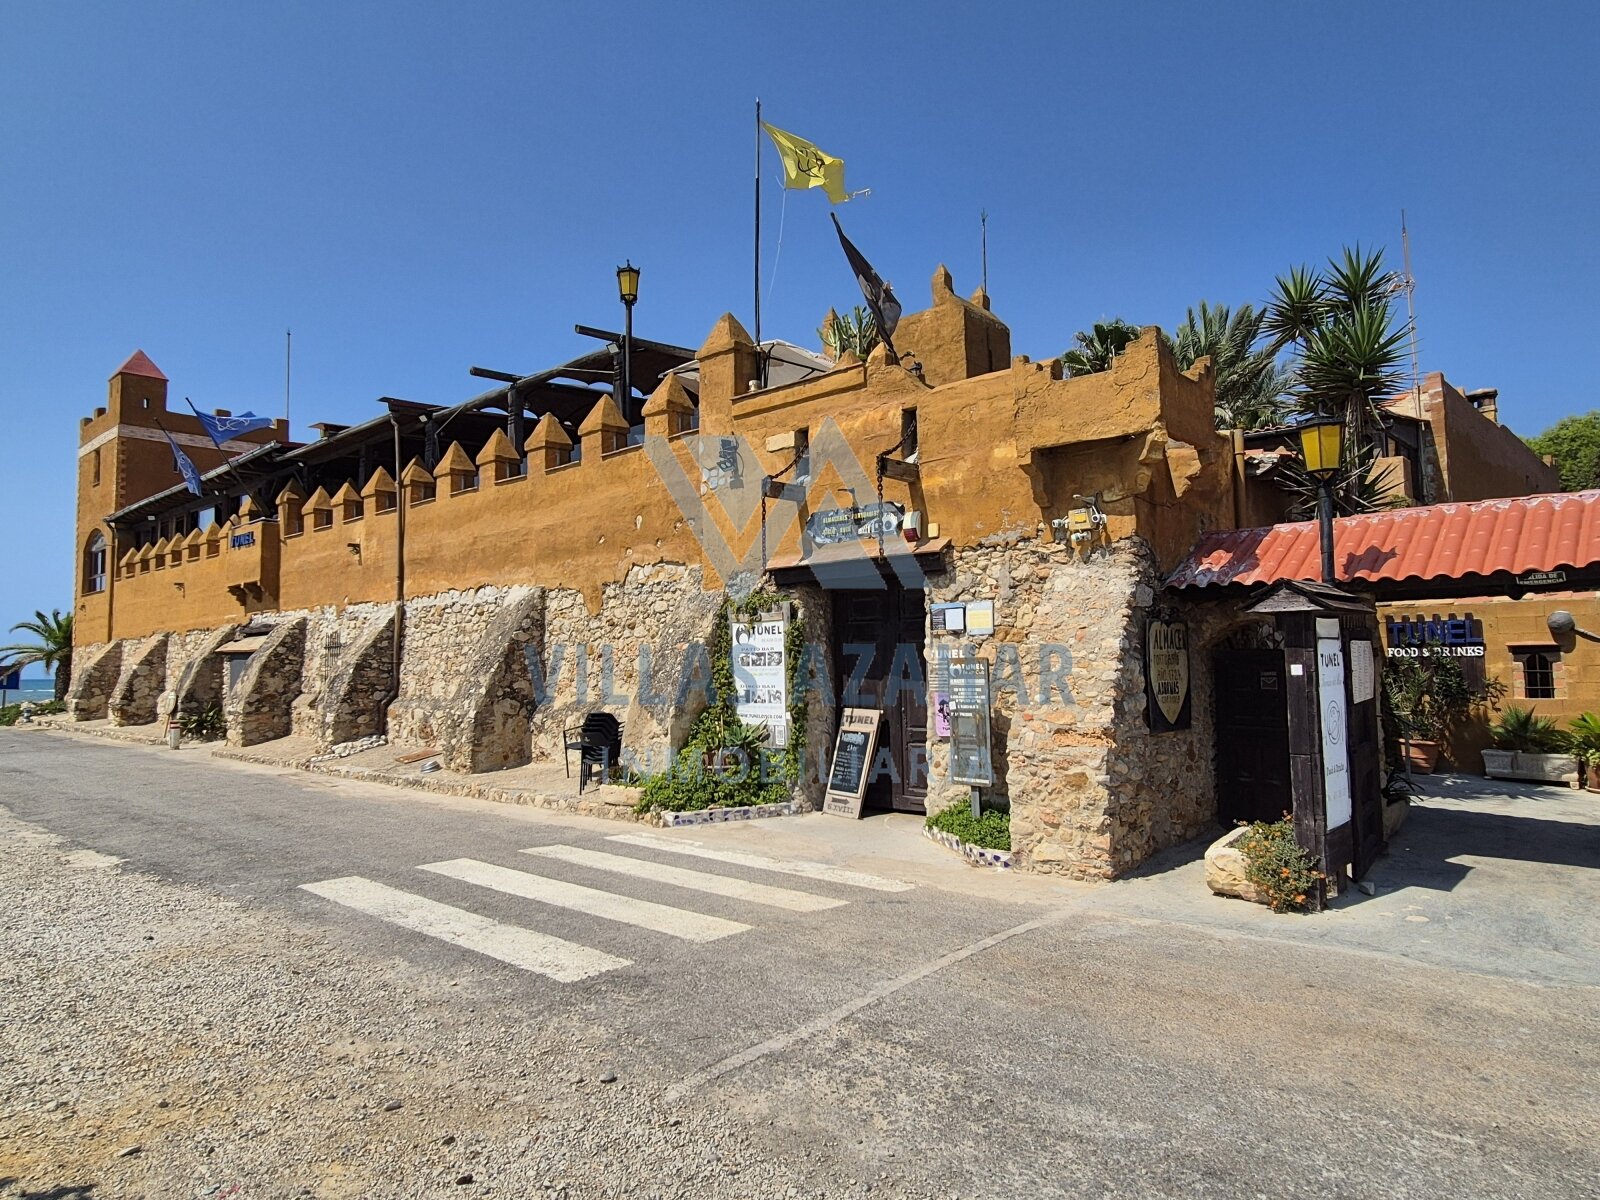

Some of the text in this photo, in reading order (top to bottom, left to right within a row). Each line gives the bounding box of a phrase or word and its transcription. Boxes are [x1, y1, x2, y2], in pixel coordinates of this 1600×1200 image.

[231, 531, 255, 548] TUNEL
[752, 625, 782, 636] TUNEL
[1388, 619, 1483, 645] TUNEL
[1388, 647, 1419, 658] FOOD
[1422, 648, 1431, 657] &
[1320, 653, 1340, 668] TUNEL
[845, 714, 874, 725] TUNEL
